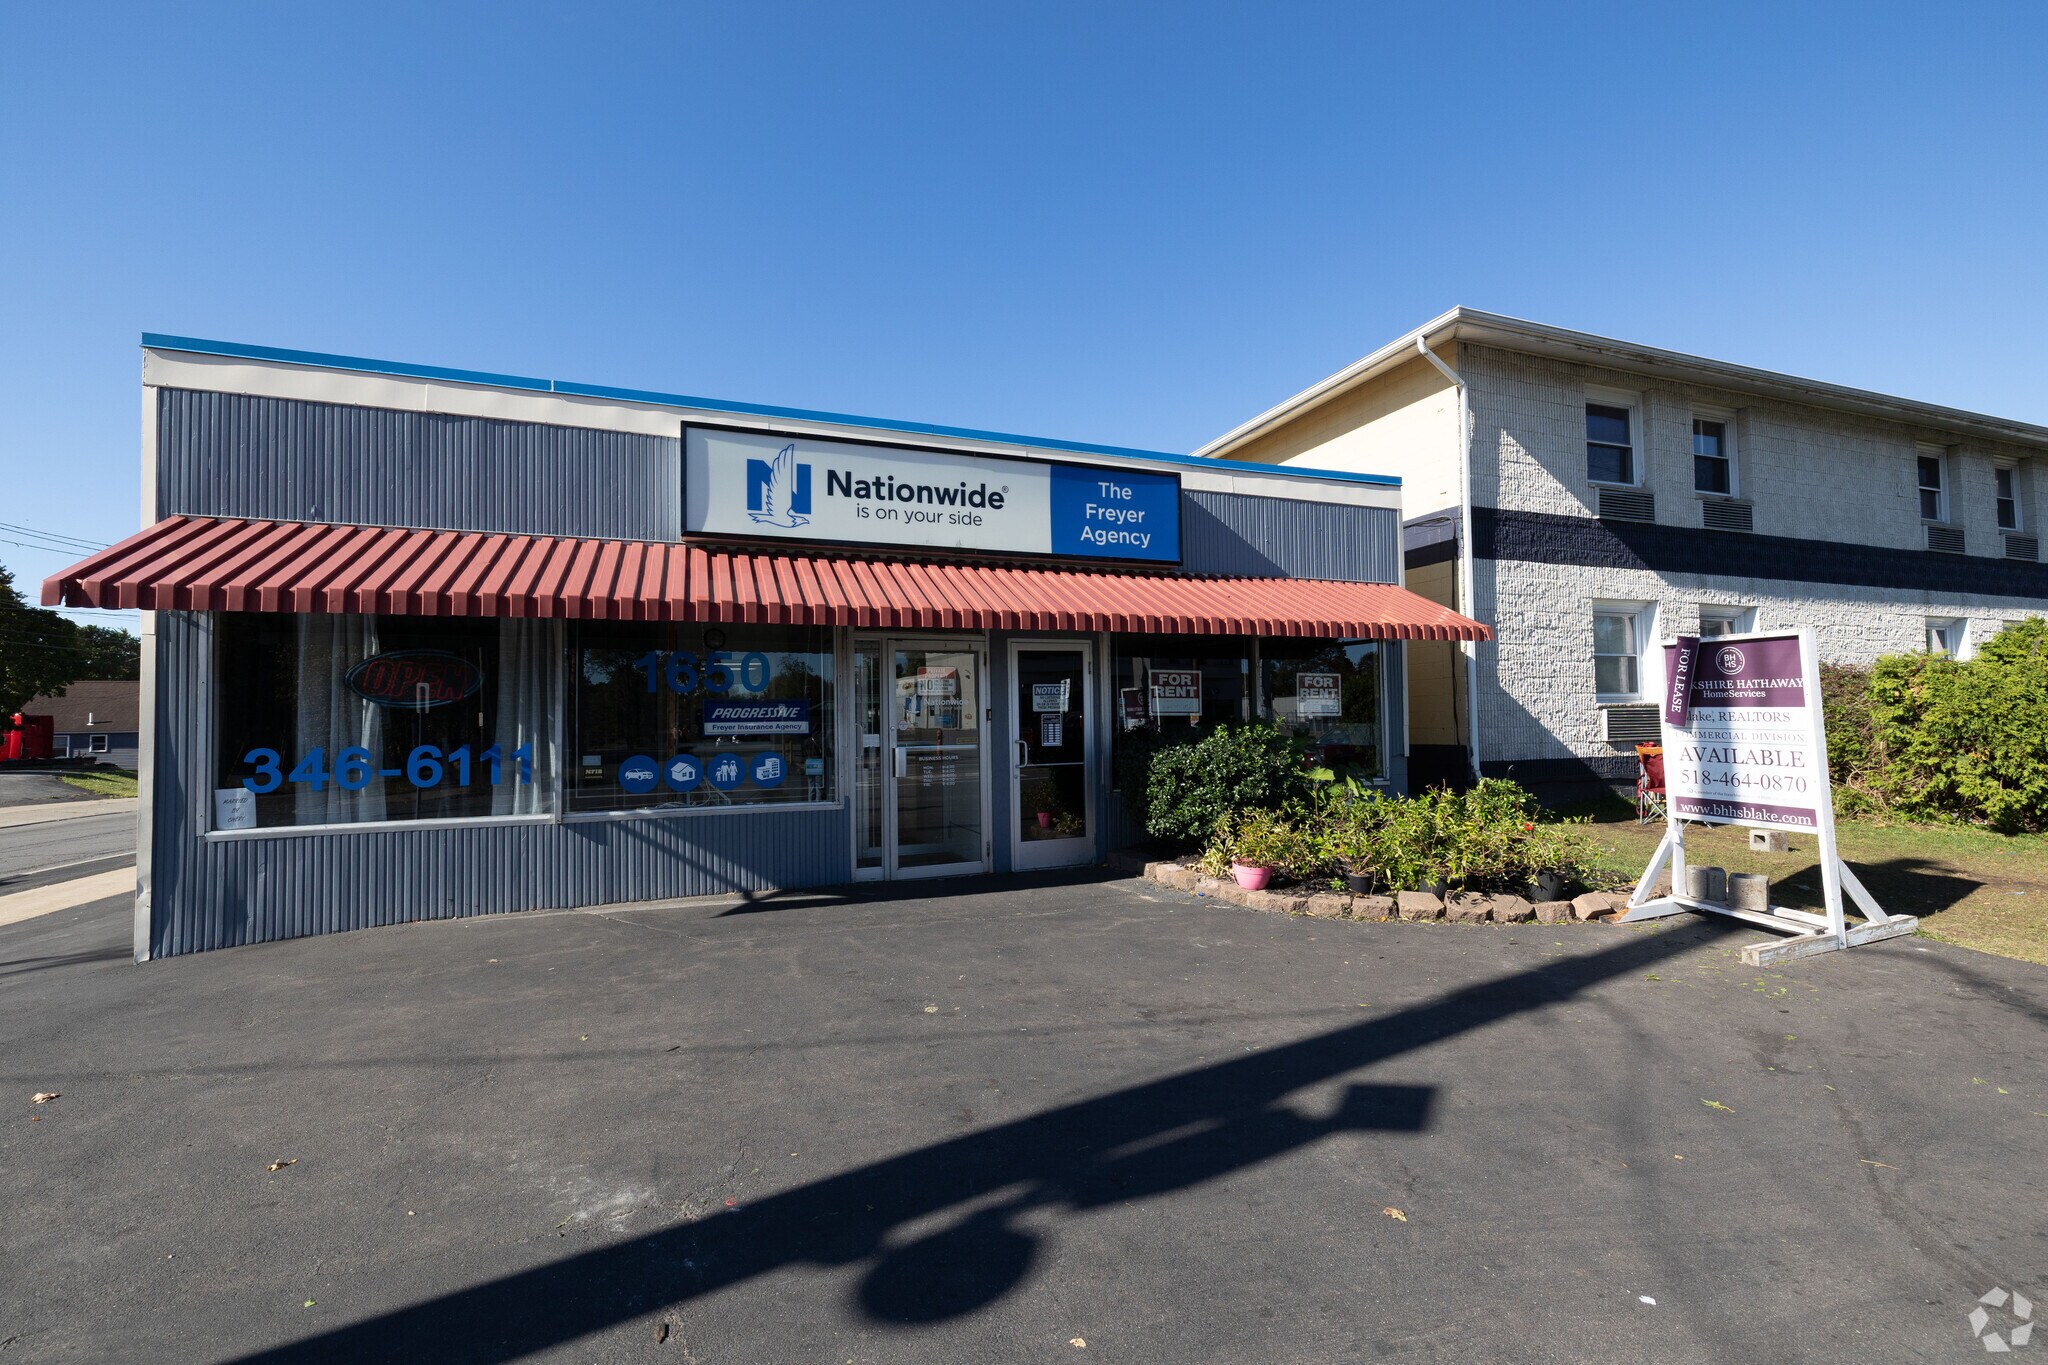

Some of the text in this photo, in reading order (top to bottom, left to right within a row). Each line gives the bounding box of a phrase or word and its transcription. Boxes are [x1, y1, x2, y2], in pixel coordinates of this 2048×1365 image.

[1098, 482, 1132, 500] The
[856, 503, 982, 526] is on your side
[1086, 503, 1145, 525] Freyer
[1080, 526, 1151, 548] Agency
[636, 651, 770, 692] 1650
[362, 658, 470, 701] OPEN
[1158, 674, 1191, 685] FOR
[1304, 676, 1333, 687] FOR
[1671, 648, 1691, 713] FOR LEASE
[1690, 678, 1804, 690] KSHIRE HATHAWAY
[1153, 686, 1197, 697] RENT
[1300, 688, 1338, 698] RENT
[1703, 689, 1766, 698] HomeServices
[924, 697, 969, 706] Nationwide
[711, 707, 800, 719] PROGRESSIVE
[1687, 710, 1791, 723] lake, REALTORS
[738, 723, 774, 731] Insurance
[775, 723, 802, 731] Agency
[1675, 731, 1805, 742] COMMERCIAL DIVISION
[1680, 746, 1806, 768] AVAILABLE
[241, 743, 532, 794] 346-6111
[1681, 769, 1807, 793] 518-464-0870
[1680, 803, 1813, 826] www.bhhsblake.com
